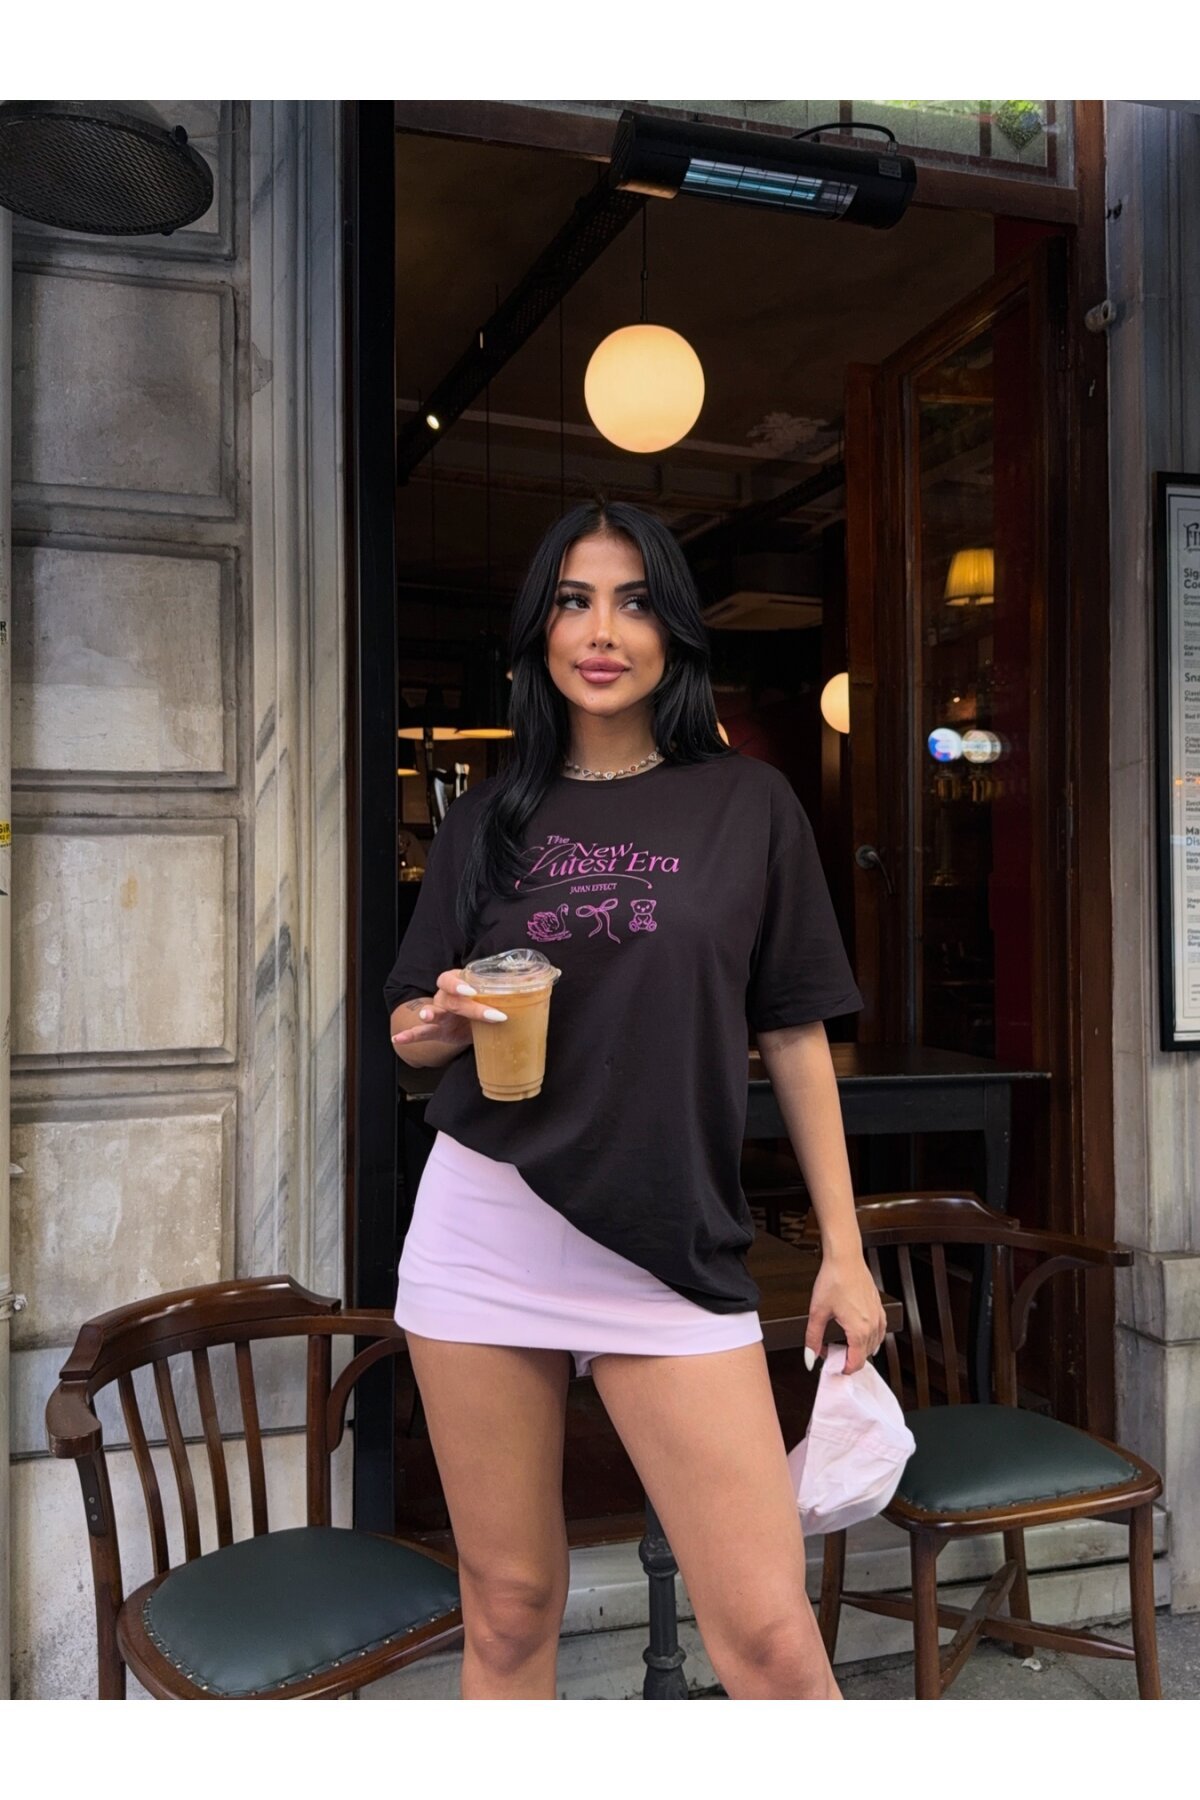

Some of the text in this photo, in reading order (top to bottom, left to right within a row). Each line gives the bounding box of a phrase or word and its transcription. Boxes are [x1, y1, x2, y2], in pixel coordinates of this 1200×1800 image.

[547, 835, 633, 858] The New
[625, 851, 680, 873] Era
[570, 883, 618, 894] JAPAN EFFECT
